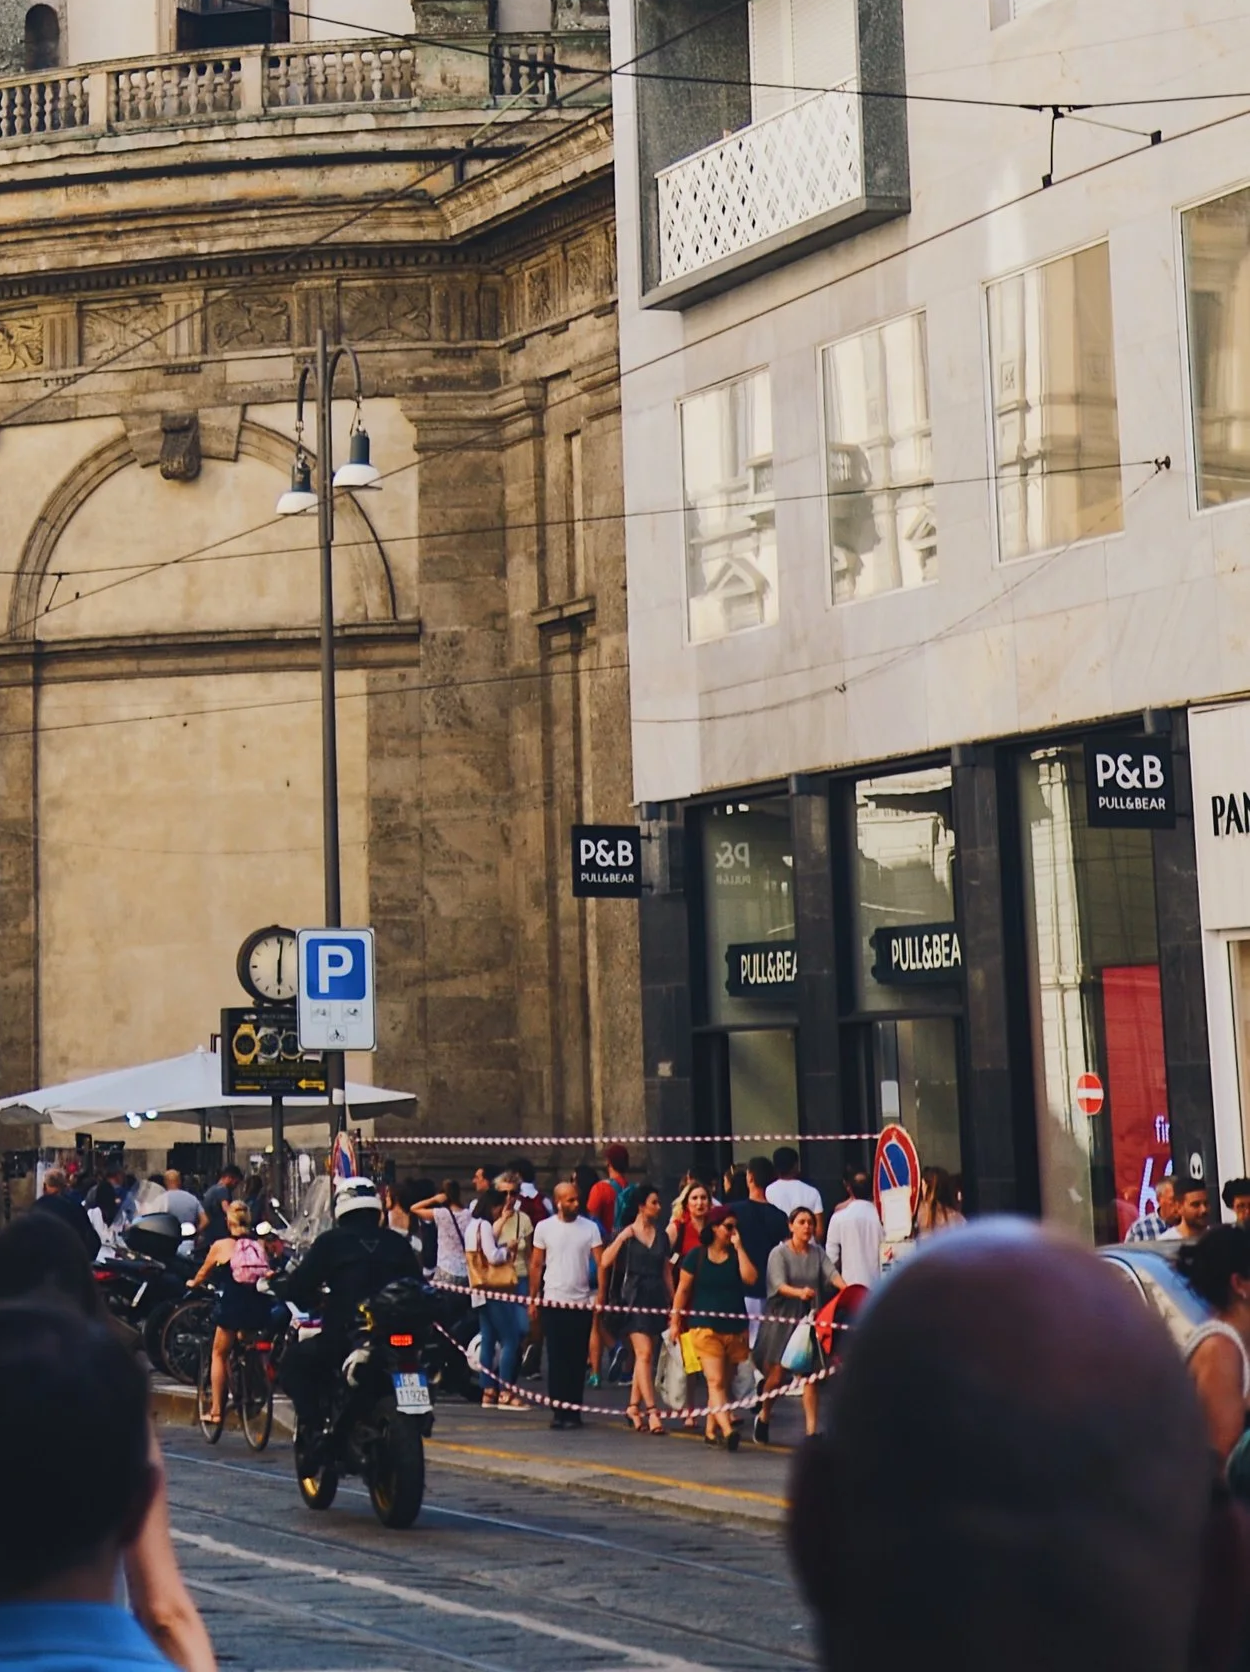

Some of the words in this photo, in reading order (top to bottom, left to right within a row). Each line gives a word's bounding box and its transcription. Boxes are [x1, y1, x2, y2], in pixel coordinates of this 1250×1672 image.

[1095, 753, 1165, 790] P&B
[1098, 796, 1167, 811] PULL&BEAR
[580, 839, 634, 867] P&B
[580, 873, 635, 884] PULL&BEAR
[318, 945, 354, 994] P
[740, 950, 798, 985] PULL&BEA
[891, 932, 962, 972] PULL&BEA
